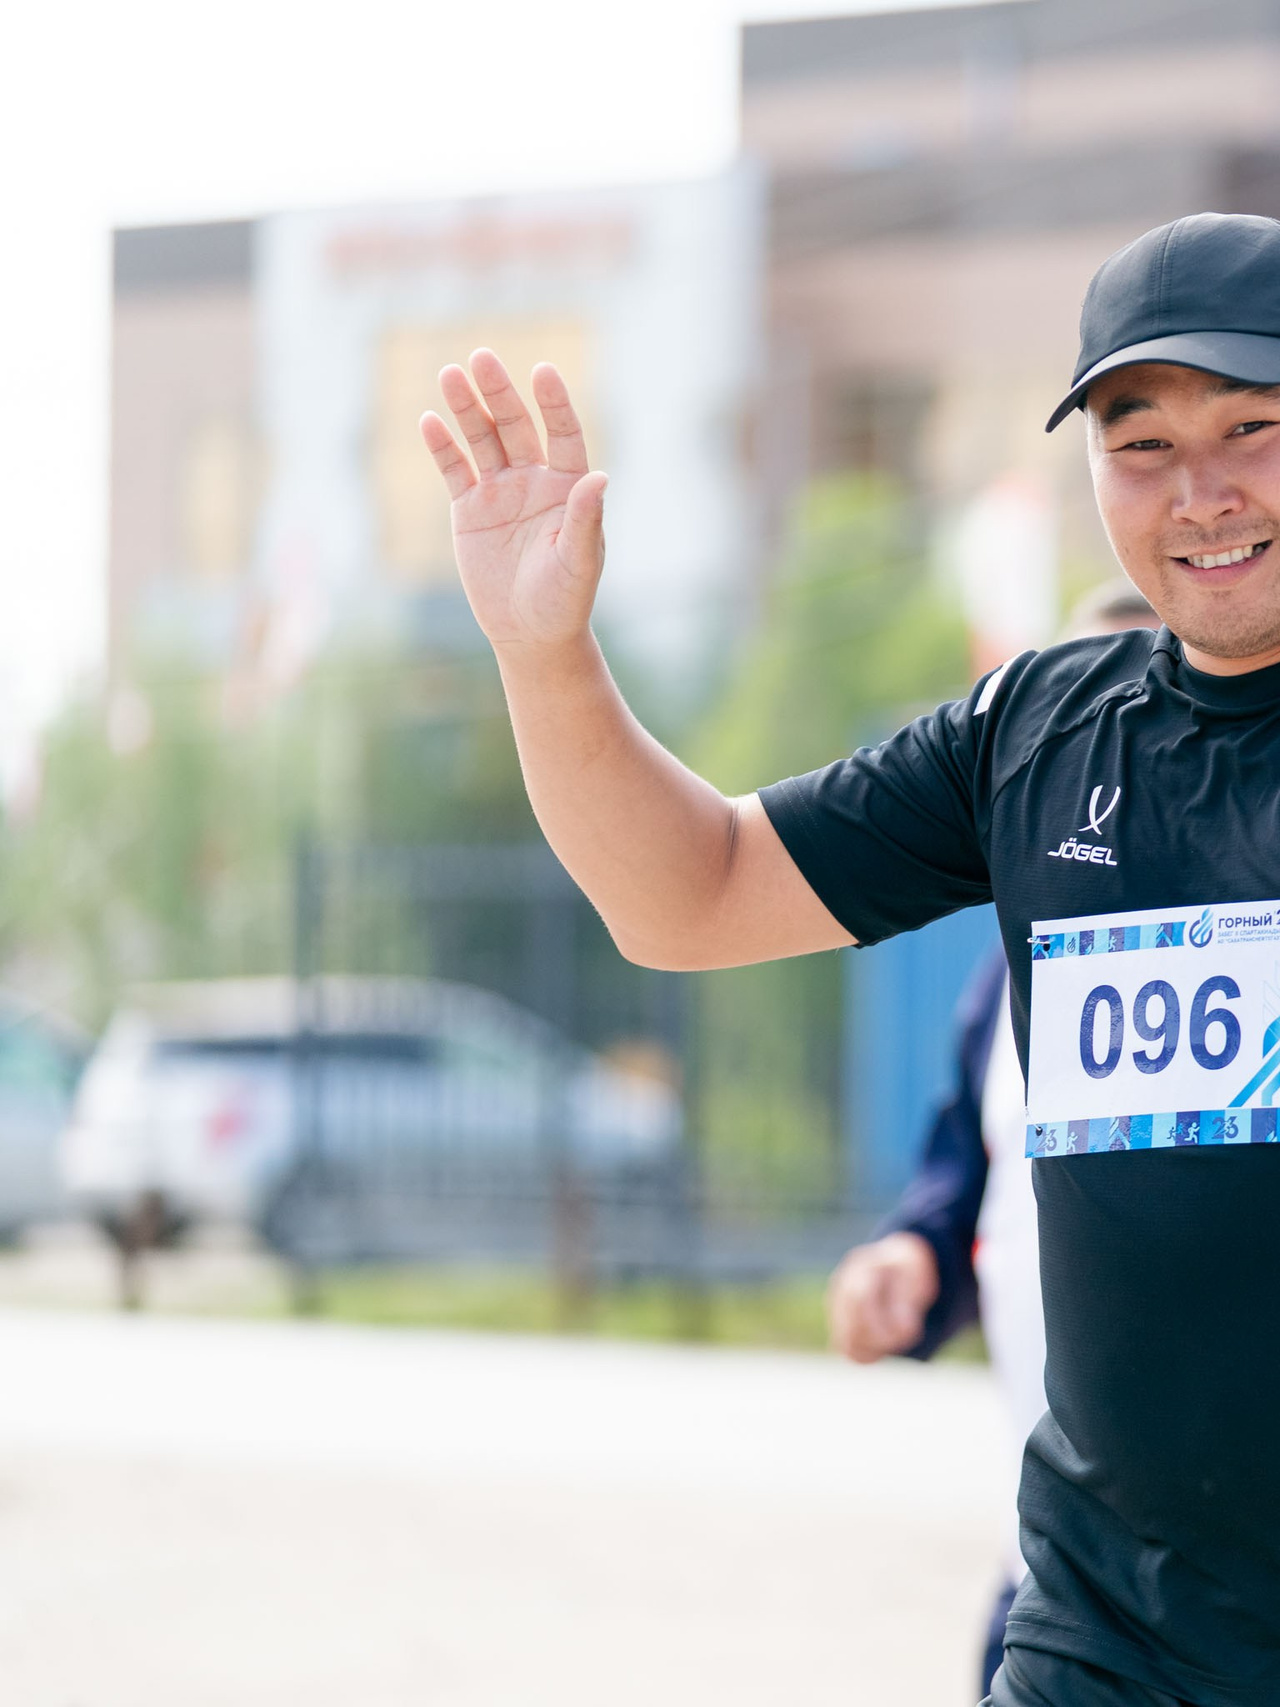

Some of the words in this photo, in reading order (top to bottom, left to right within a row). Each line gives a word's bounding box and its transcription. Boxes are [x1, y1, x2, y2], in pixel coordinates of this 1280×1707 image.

[1047, 837, 1118, 866] JÖGEL
[1218, 913, 1272, 929] ГОРНЫЙ
[1080, 975, 1242, 1079] 096
